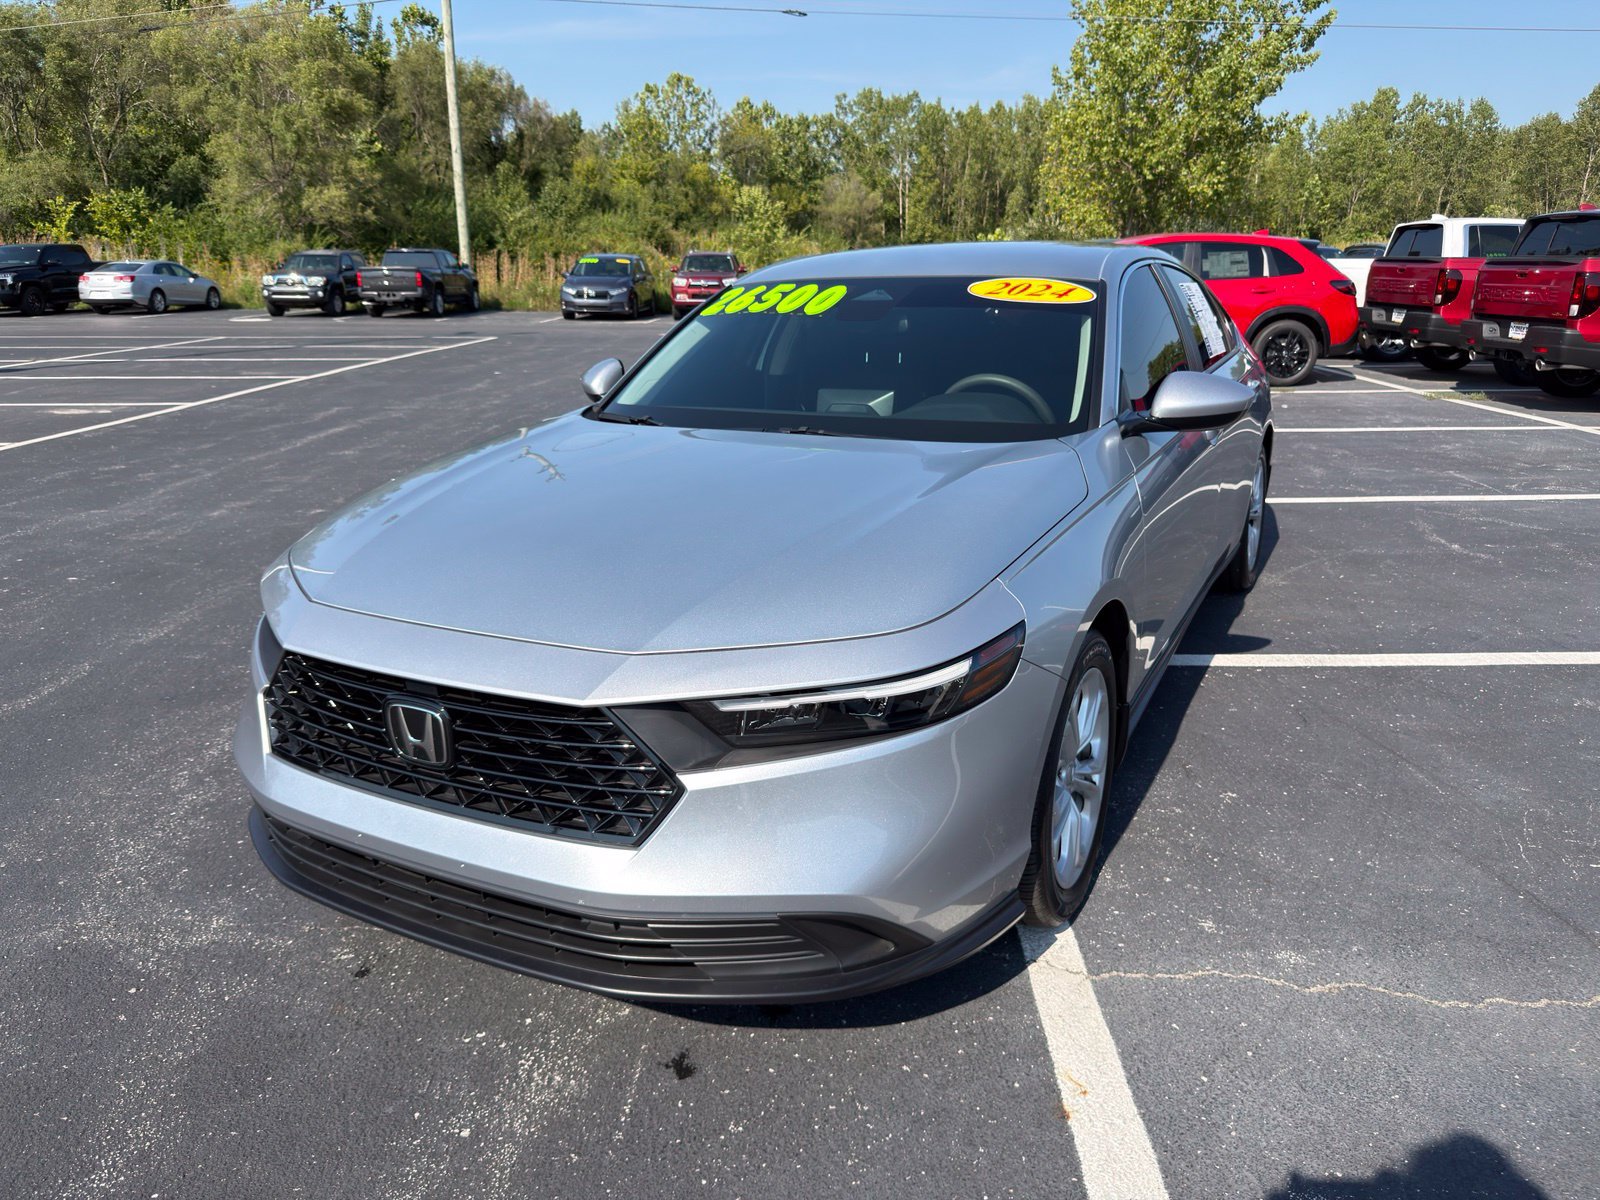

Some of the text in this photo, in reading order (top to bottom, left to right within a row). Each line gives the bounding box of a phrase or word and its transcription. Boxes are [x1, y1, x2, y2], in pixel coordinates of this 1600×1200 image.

[700, 284, 847, 316] 26500
[984, 282, 1077, 299] 2024
[397, 705, 438, 764] H
